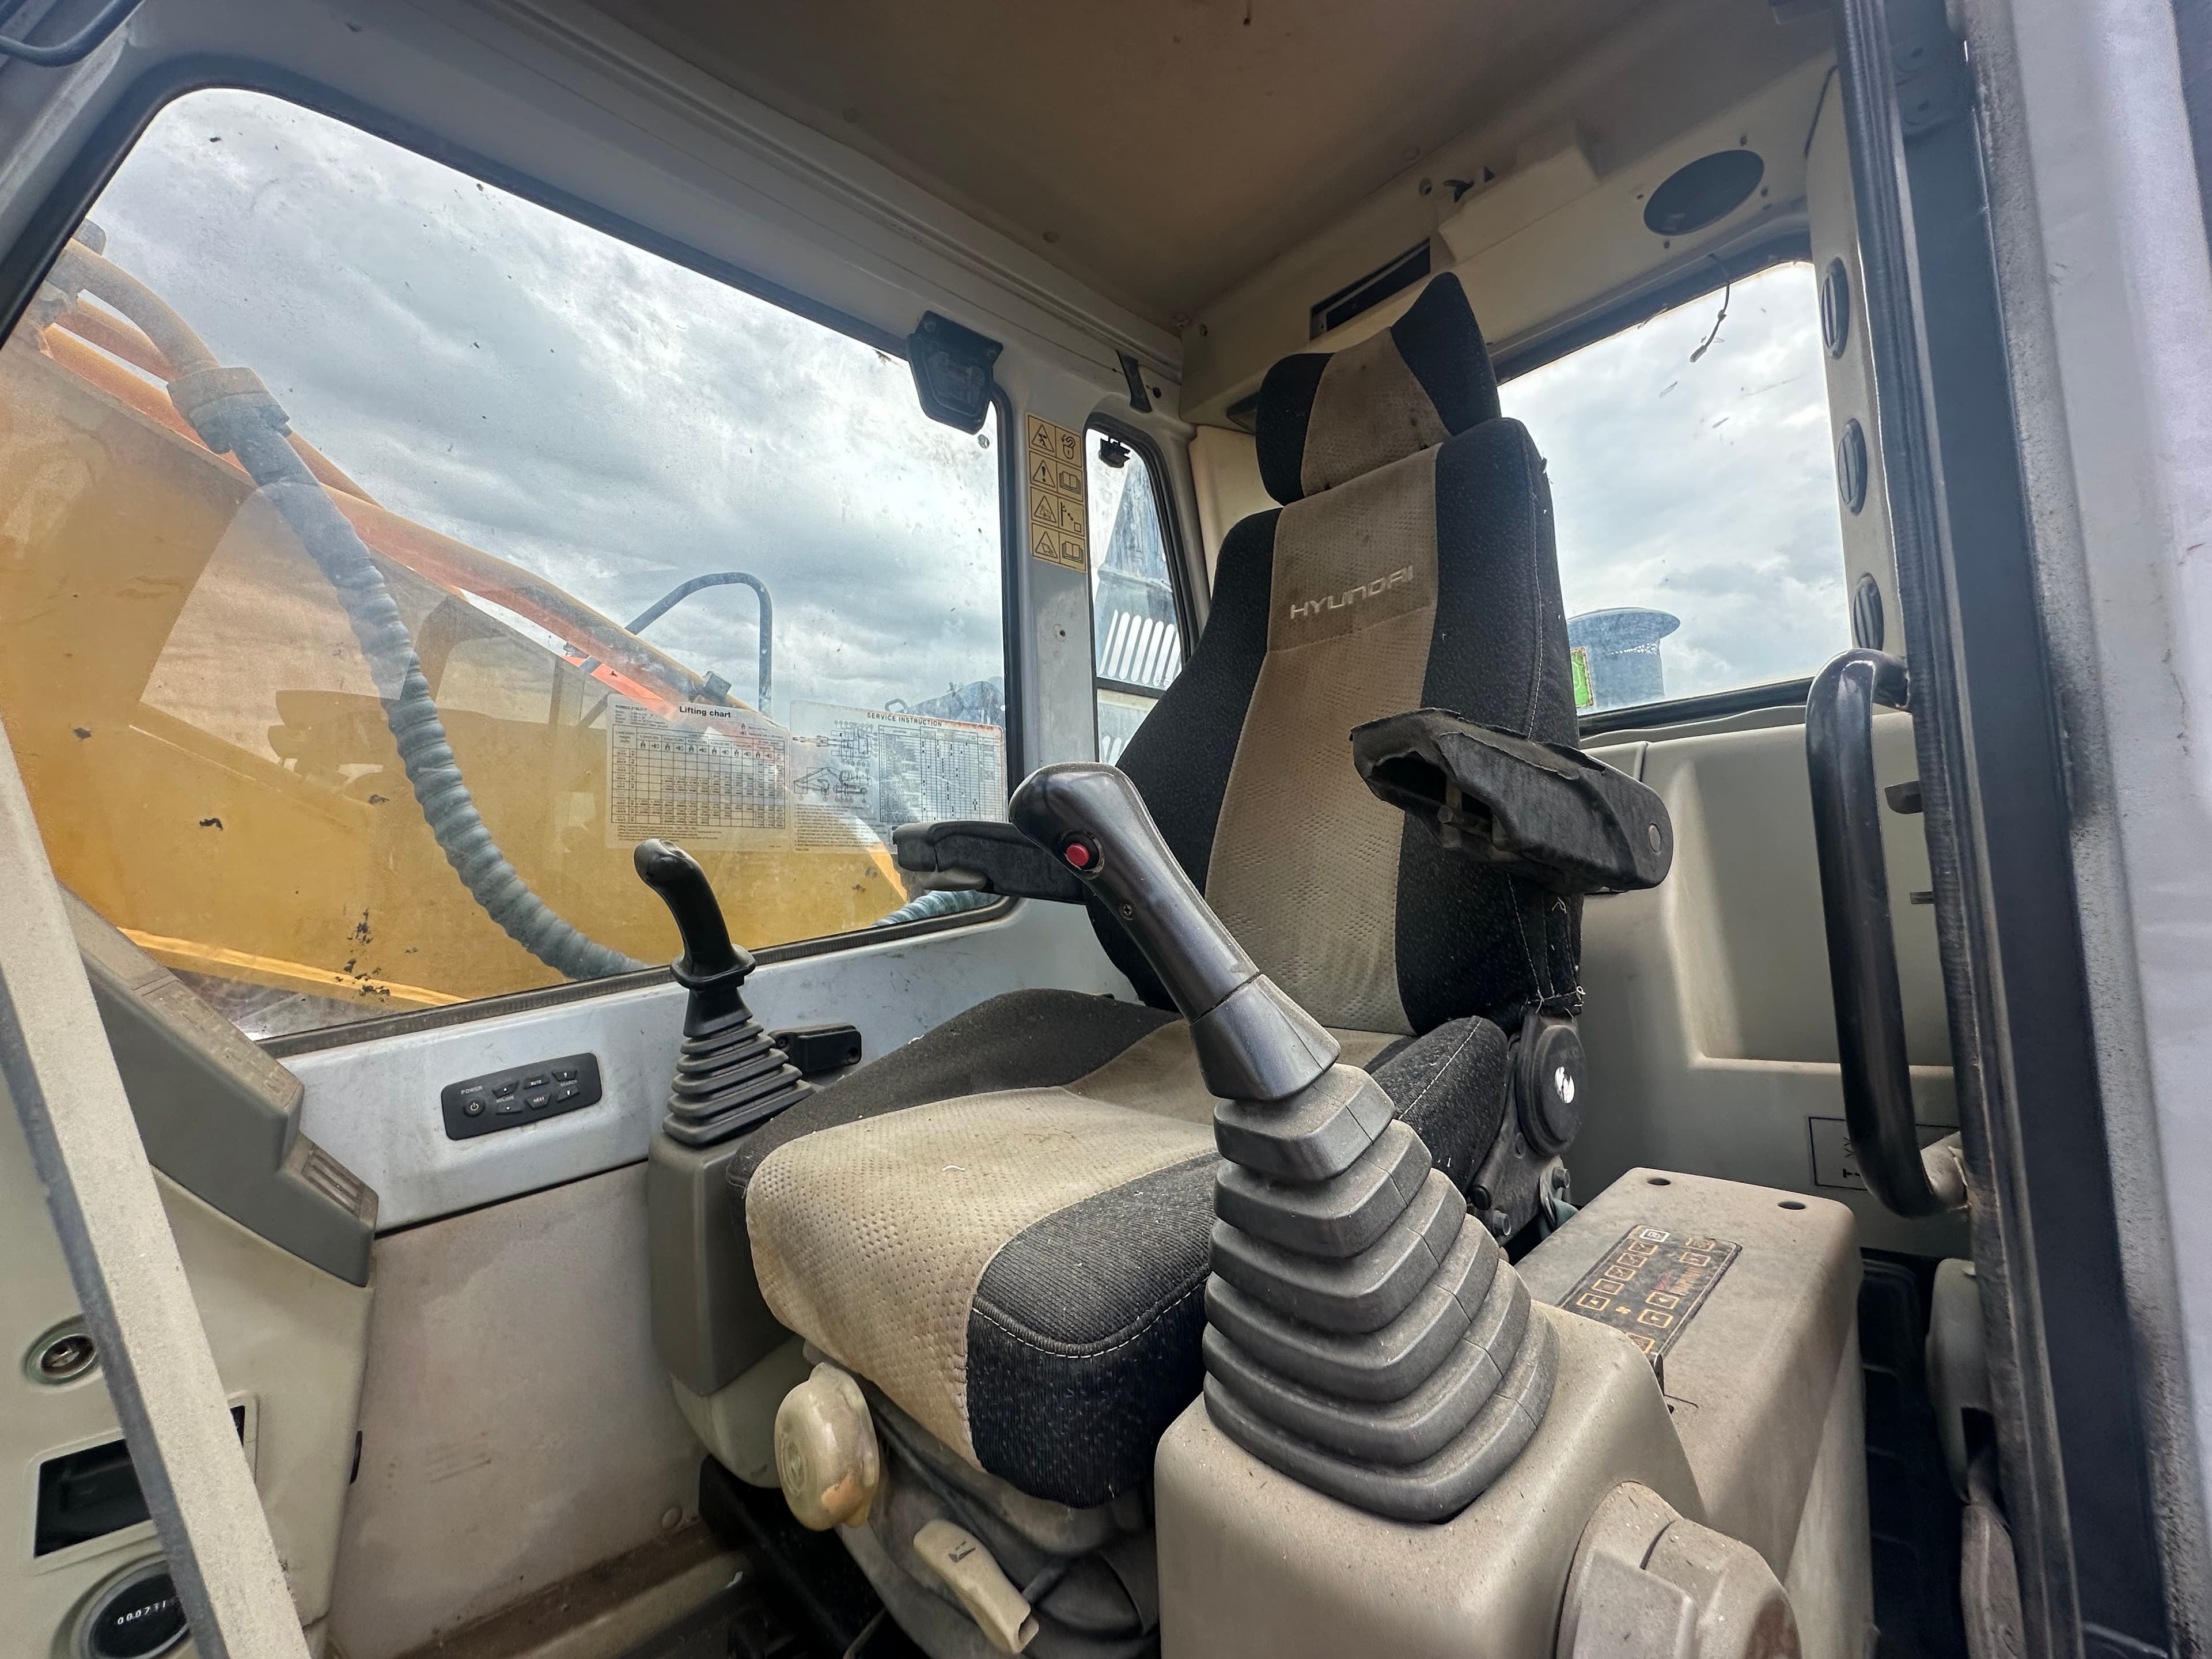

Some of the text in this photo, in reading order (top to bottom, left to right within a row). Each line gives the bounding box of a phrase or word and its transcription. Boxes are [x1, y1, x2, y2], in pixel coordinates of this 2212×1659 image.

[1290, 565, 1414, 619] HYUNDAI
[679, 706, 731, 718] Lifting chart
[867, 712, 942, 727] SERVICE INSTRUCTION
[461, 1085, 483, 1095] POWER
